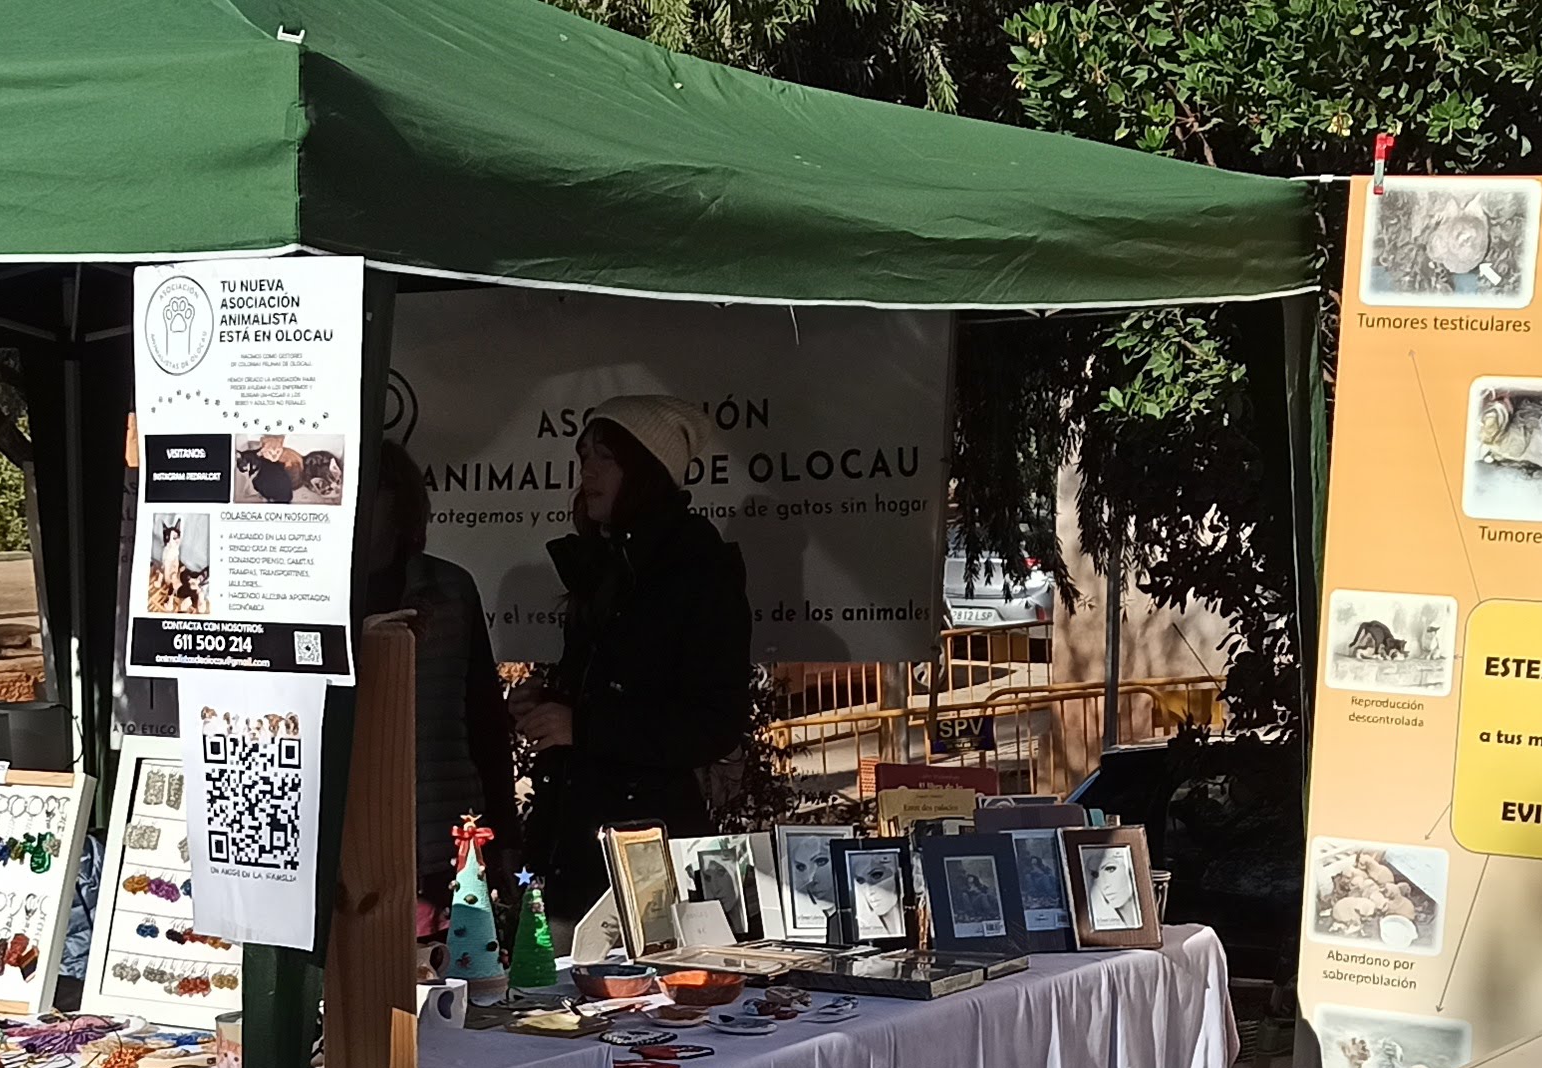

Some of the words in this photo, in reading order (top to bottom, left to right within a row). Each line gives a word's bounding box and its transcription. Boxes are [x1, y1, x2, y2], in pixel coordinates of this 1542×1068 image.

[219, 279, 237, 293] TU
[239, 277, 285, 293] NUEVA
[219, 294, 300, 310] ASOCIACIÓN
[219, 311, 298, 326] ANIMALISTA
[1355, 311, 1428, 330] Tumores
[1432, 314, 1531, 333] testiculares
[218, 329, 251, 343] ESTÁ
[253, 328, 272, 343] EN
[274, 327, 334, 342] OLOCAU
[686, 451, 732, 486] DE
[747, 444, 919, 484] OLOCAU
[743, 499, 768, 518] de
[775, 497, 834, 521] gatos
[839, 496, 868, 514] sin
[874, 494, 929, 517] hogar
[770, 601, 796, 622] de
[804, 599, 834, 624] los
[840, 599, 929, 624] animales
[160, 619, 203, 631] CONTACTA
[172, 632, 193, 651] 611
[194, 633, 226, 652] 500
[227, 634, 253, 654] 214
[1349, 694, 1425, 711] Reproducción
[141, 721, 177, 735] ÉTICO
[1347, 710, 1424, 728] descontrolada
[1477, 727, 1496, 743] a
[1493, 727, 1523, 746] tus
[1325, 948, 1391, 968] Abandono
[1392, 958, 1415, 971] por
[1321, 967, 1417, 990] sobrepoblación
